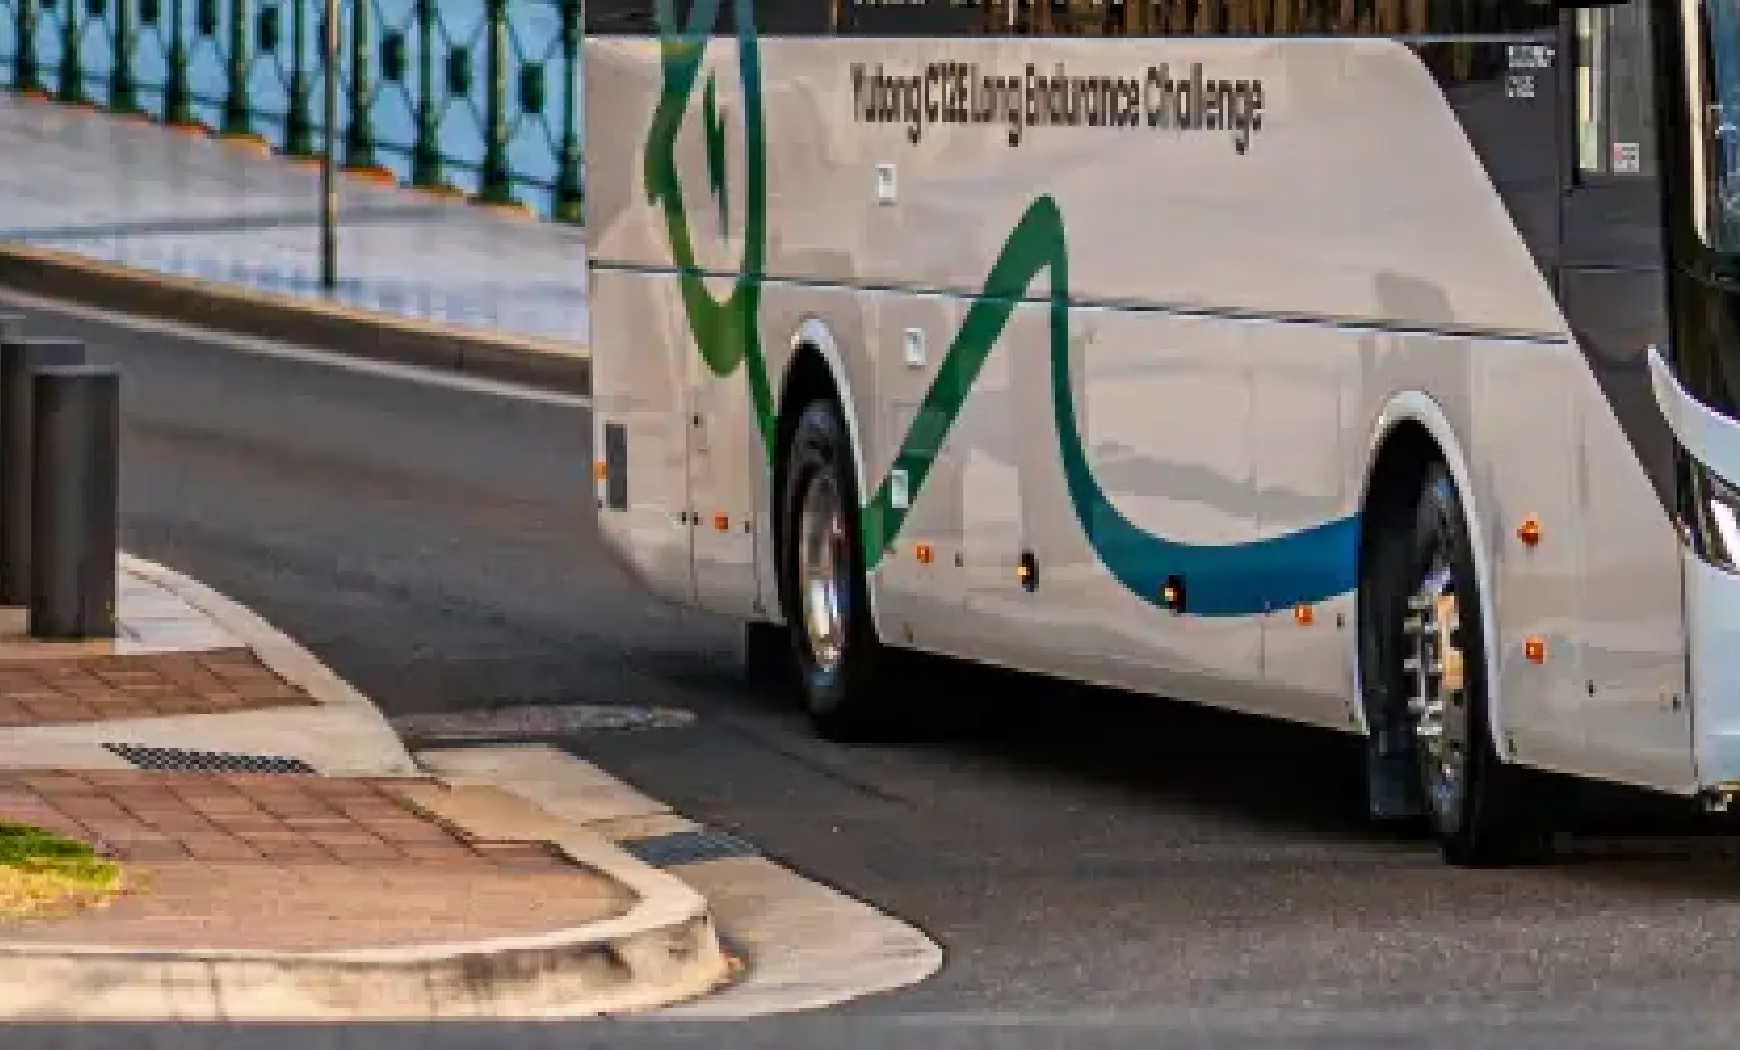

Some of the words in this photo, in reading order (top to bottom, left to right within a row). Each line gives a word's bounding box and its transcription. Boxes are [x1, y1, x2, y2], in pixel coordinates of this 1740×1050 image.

[970, 62, 1022, 148] Long
[1026, 62, 1140, 128] Endurance
[1143, 62, 1263, 157] Challenge
